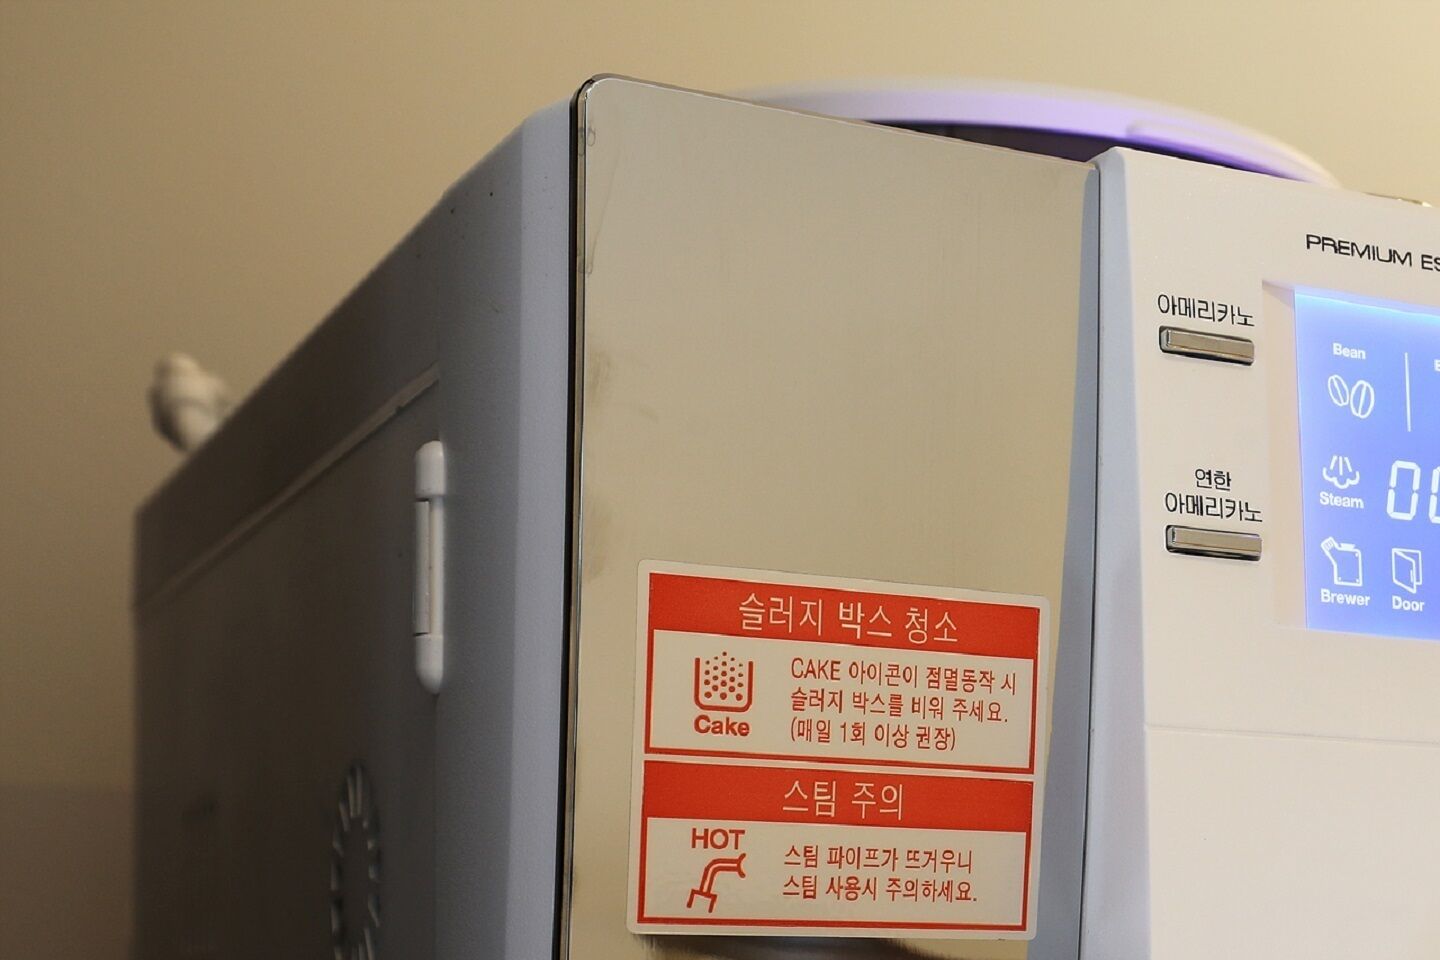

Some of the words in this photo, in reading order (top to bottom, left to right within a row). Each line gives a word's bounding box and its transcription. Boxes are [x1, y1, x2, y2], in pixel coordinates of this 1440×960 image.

[1305, 233, 1413, 268] PREMIUM
[1157, 293, 1255, 327] 아메리카노
[1332, 342, 1366, 361] Bean
[1195, 468, 1232, 491] 연한
[1165, 492, 1263, 522] 아메리카노
[1319, 491, 1364, 510] Steam
[1320, 588, 1370, 608] Brewer
[1392, 595, 1425, 613] Door
[738, 593, 825, 636] 슬러지
[838, 602, 893, 639] 박스
[904, 607, 959, 645] 청소
[791, 657, 842, 682] CAKE
[848, 661, 920, 691] 아이콘이
[925, 666, 996, 694] 점멸동작
[1000, 671, 1017, 696] 시
[790, 686, 844, 714] 슬러지
[851, 690, 904, 718] 박스를
[911, 696, 945, 720] 비워
[951, 699, 1009, 724] 주세요.
[693, 714, 751, 738] Cake
[790, 718, 832, 744] (매일
[839, 721, 867, 747] 1회
[874, 726, 910, 751] 이상
[915, 727, 956, 752] 권장)
[782, 780, 839, 818] 스팀
[850, 781, 904, 822] 주의
[691, 827, 746, 851] HOT
[783, 844, 819, 869] 스팀
[826, 847, 899, 873] 파이프가
[904, 849, 974, 874] 뜨거우니
[782, 875, 818, 900] 스팀
[825, 877, 878, 901] 사용시
[885, 880, 978, 904] 주의하세요.
